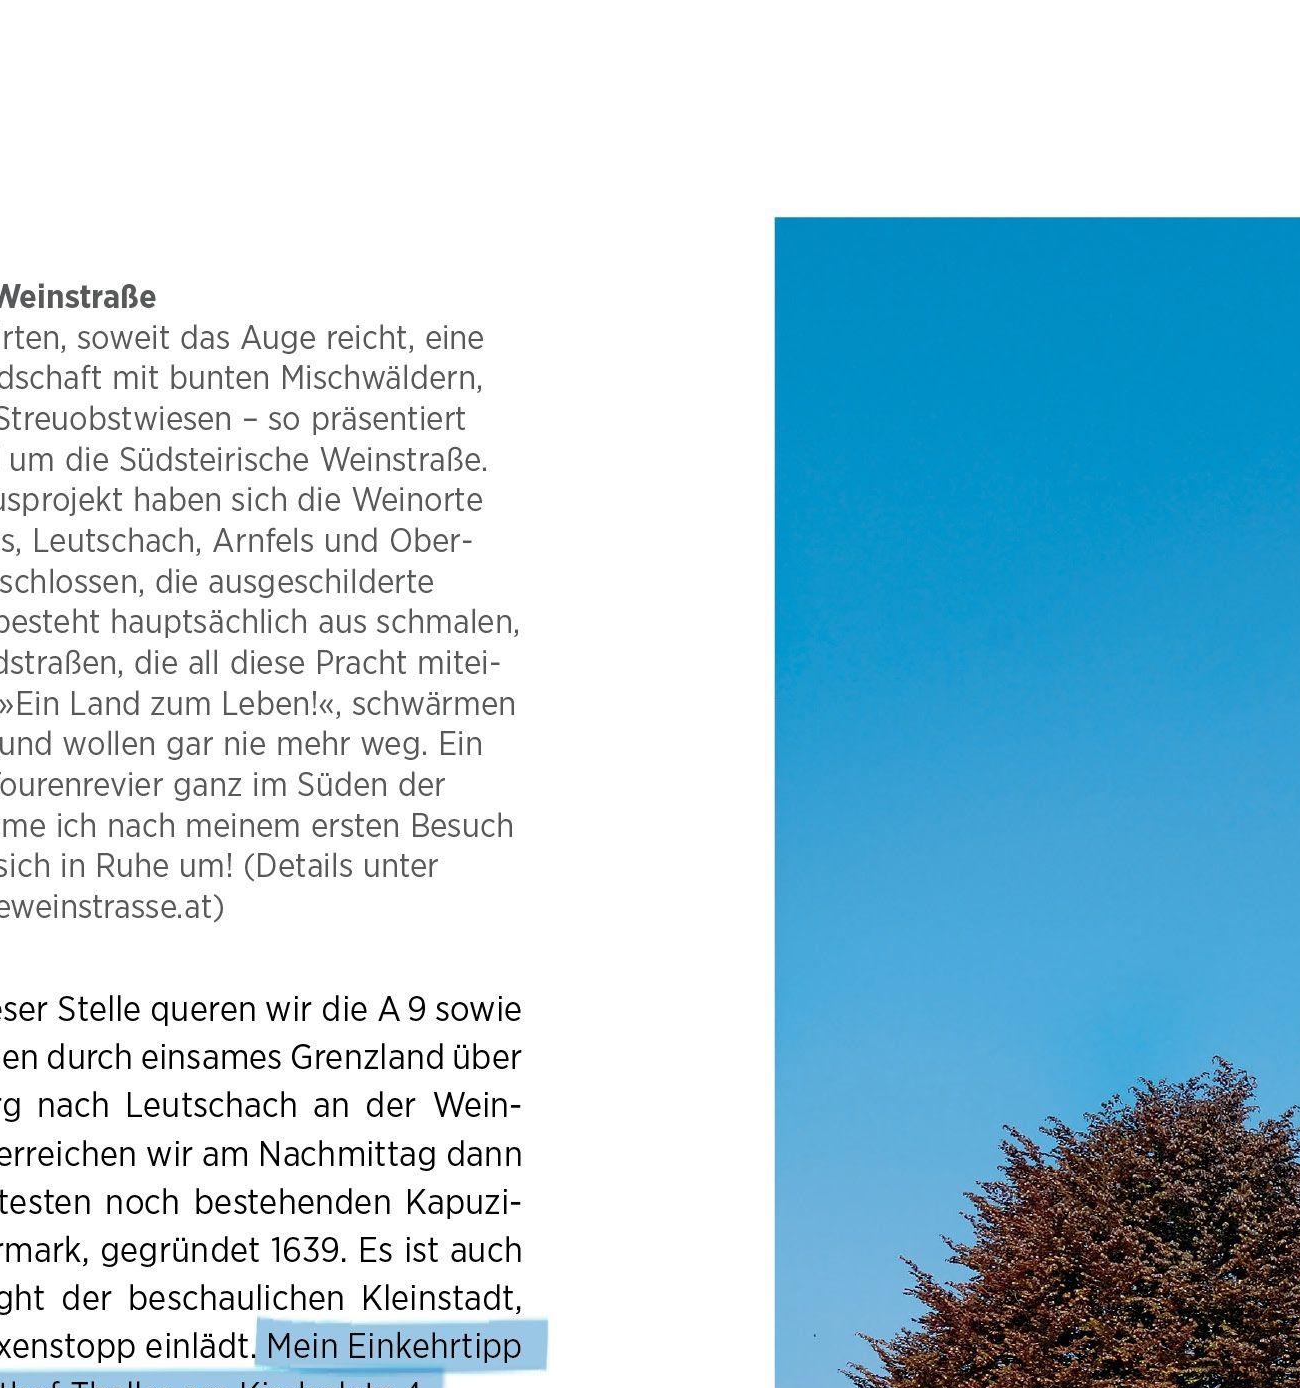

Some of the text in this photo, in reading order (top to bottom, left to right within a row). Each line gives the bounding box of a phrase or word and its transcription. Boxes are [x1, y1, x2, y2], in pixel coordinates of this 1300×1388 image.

[77, 324, 170, 350] soweit
[181, 324, 230, 350] das
[240, 324, 316, 355] Auge
[328, 324, 414, 353] reicht,
[426, 324, 484, 350] eine
[135, 486, 221, 512] haben
[231, 486, 287, 512] sich
[298, 486, 341, 512] die
[352, 486, 483, 512] Weinorte
[135, 649, 178, 675] die
[189, 649, 218, 675] all
[231, 649, 305, 675] diese
[317, 649, 407, 675] Pracht
[419, 649, 500, 675] mitei-
[58, 994, 141, 1022] Stelle
[151, 1001, 256, 1027] queren
[265, 995, 312, 1022] wir
[322, 994, 368, 1022] die
[377, 995, 401, 1022] A
[408, 995, 426, 1022] 9
[435, 995, 522, 1022] sowie
[145, 1331, 256, 1359] einlädt.
[268, 1332, 338, 1359] Mein
[349, 1331, 522, 1364] Einkehrtipp
